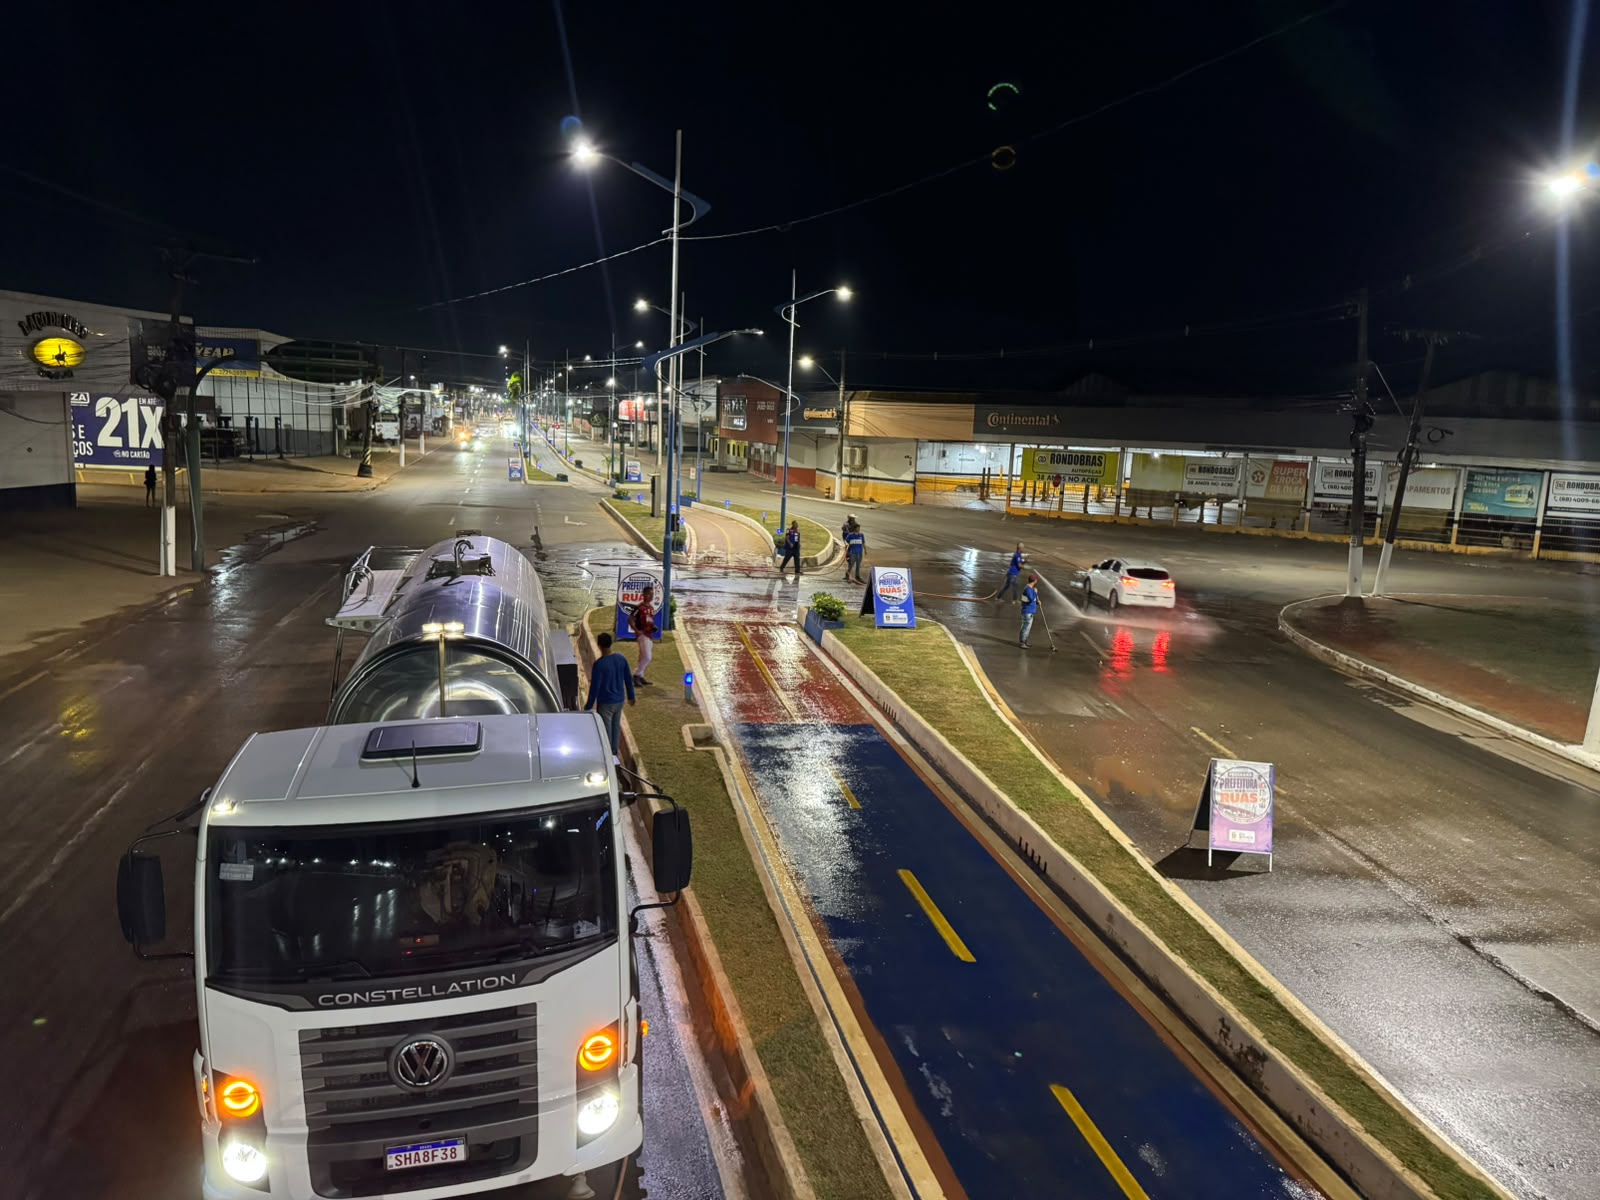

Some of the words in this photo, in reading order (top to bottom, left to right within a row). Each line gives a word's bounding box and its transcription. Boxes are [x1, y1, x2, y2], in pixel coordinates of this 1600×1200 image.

[95, 396, 165, 449] 21X
[987, 412, 1050, 427] Continental
[130, 450, 151, 459] CARTÃO
[1050, 453, 1103, 467] RONDOBRAS
[1198, 466, 1235, 475] RONDOBRAS
[1273, 466, 1306, 477] SUPER
[1275, 475, 1302, 485] TROCA
[1566, 481, 1600, 491] RONDOBR
[622, 594, 644, 602] RUA
[1220, 778, 1258, 789] PREFEITURA
[1220, 793, 1257, 804] RUAS
[318, 974, 516, 1007] CONSTELLATION
[394, 1147, 457, 1167] SHA8F38
